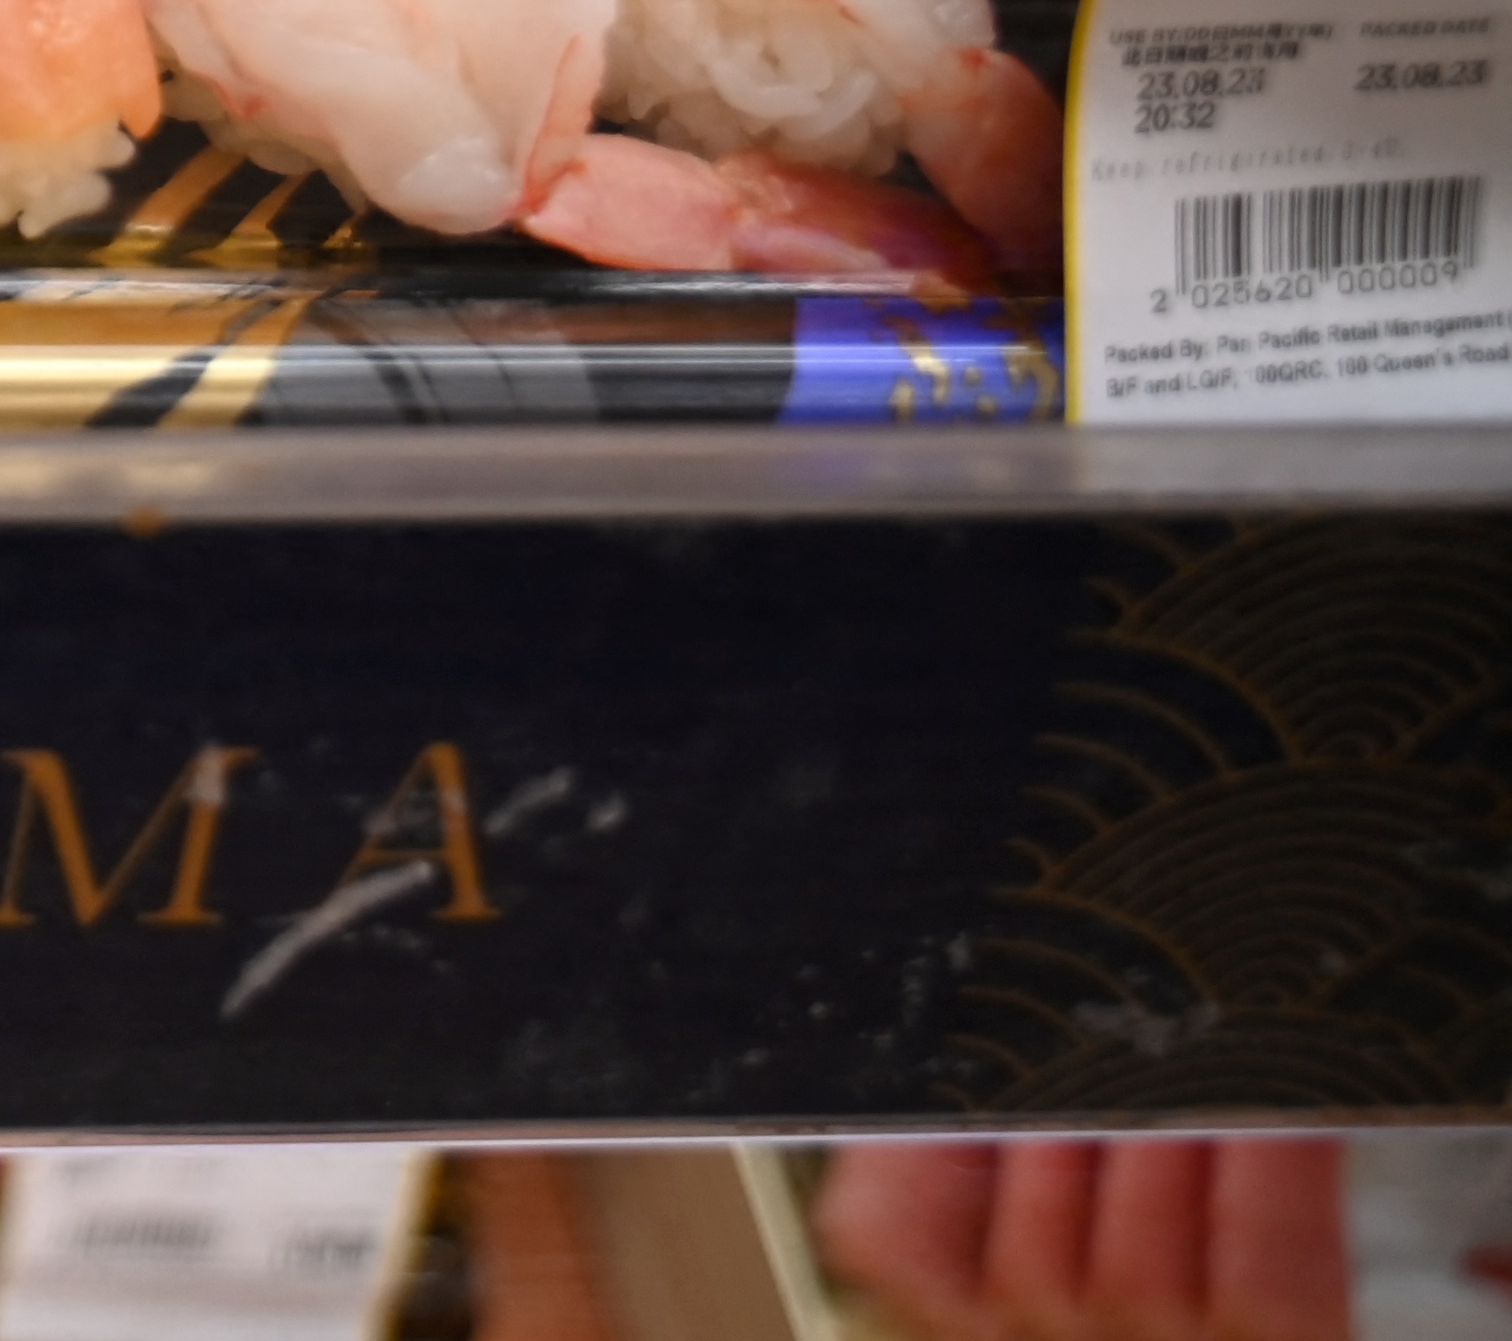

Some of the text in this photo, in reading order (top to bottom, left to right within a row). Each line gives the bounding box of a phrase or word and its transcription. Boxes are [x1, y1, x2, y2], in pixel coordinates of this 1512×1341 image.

[1360, 19, 1491, 38] PACKED DATE
[1136, 67, 1267, 102] 23.08.23
[1354, 59, 1491, 92] 23.08.23
[1134, 101, 1218, 135] 20:32
[1150, 260, 1461, 315] 2 025620 000009
[1105, 341, 1173, 366] Packed
[1259, 325, 1321, 351] Pacific
[1328, 320, 1380, 345] Retail
[1145, 370, 1181, 394] and
[1374, 345, 1454, 375] Queen's
[1459, 342, 1510, 366] Road
